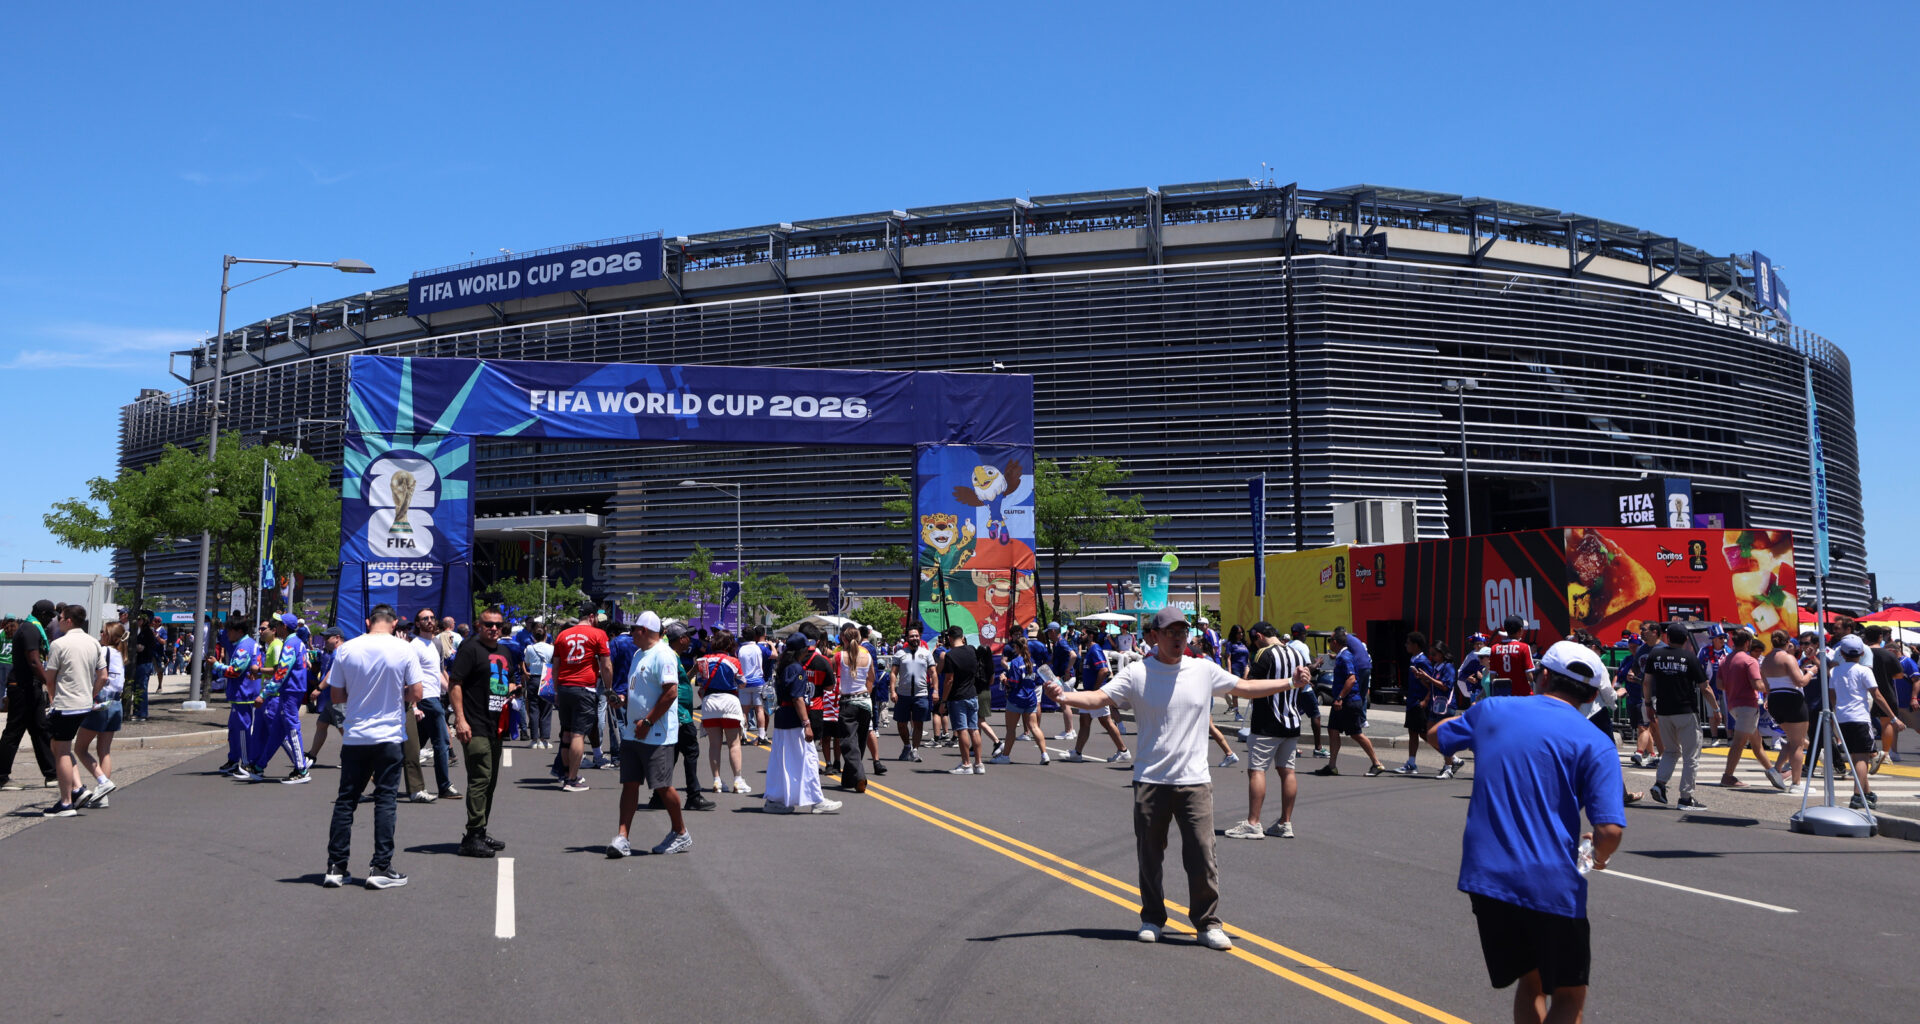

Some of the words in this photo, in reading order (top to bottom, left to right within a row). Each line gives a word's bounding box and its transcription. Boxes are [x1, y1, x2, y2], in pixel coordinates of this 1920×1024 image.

[420, 281, 454, 303] FIFA
[458, 270, 521, 297] WORLD
[527, 262, 564, 285] CUP
[570, 251, 643, 279] 2026
[530, 390, 592, 412] FIFA
[597, 391, 701, 415] WORLD
[707, 395, 764, 416] CUP
[769, 395, 867, 418] 2026
[1816, 467, 1827, 533] JERSEY
[1620, 510, 1655, 524] STORE
[387, 538, 416, 548] FIFA
[1656, 552, 1683, 560] Doritos
[367, 562, 408, 571] WORLD
[410, 562, 434, 571] CUP
[367, 572, 433, 587] 2026
[1484, 577, 1541, 631] GOAL
[567, 640, 585, 660] 25
[1496, 645, 1520, 654] ERIC
[1503, 655, 1511, 672] 8
